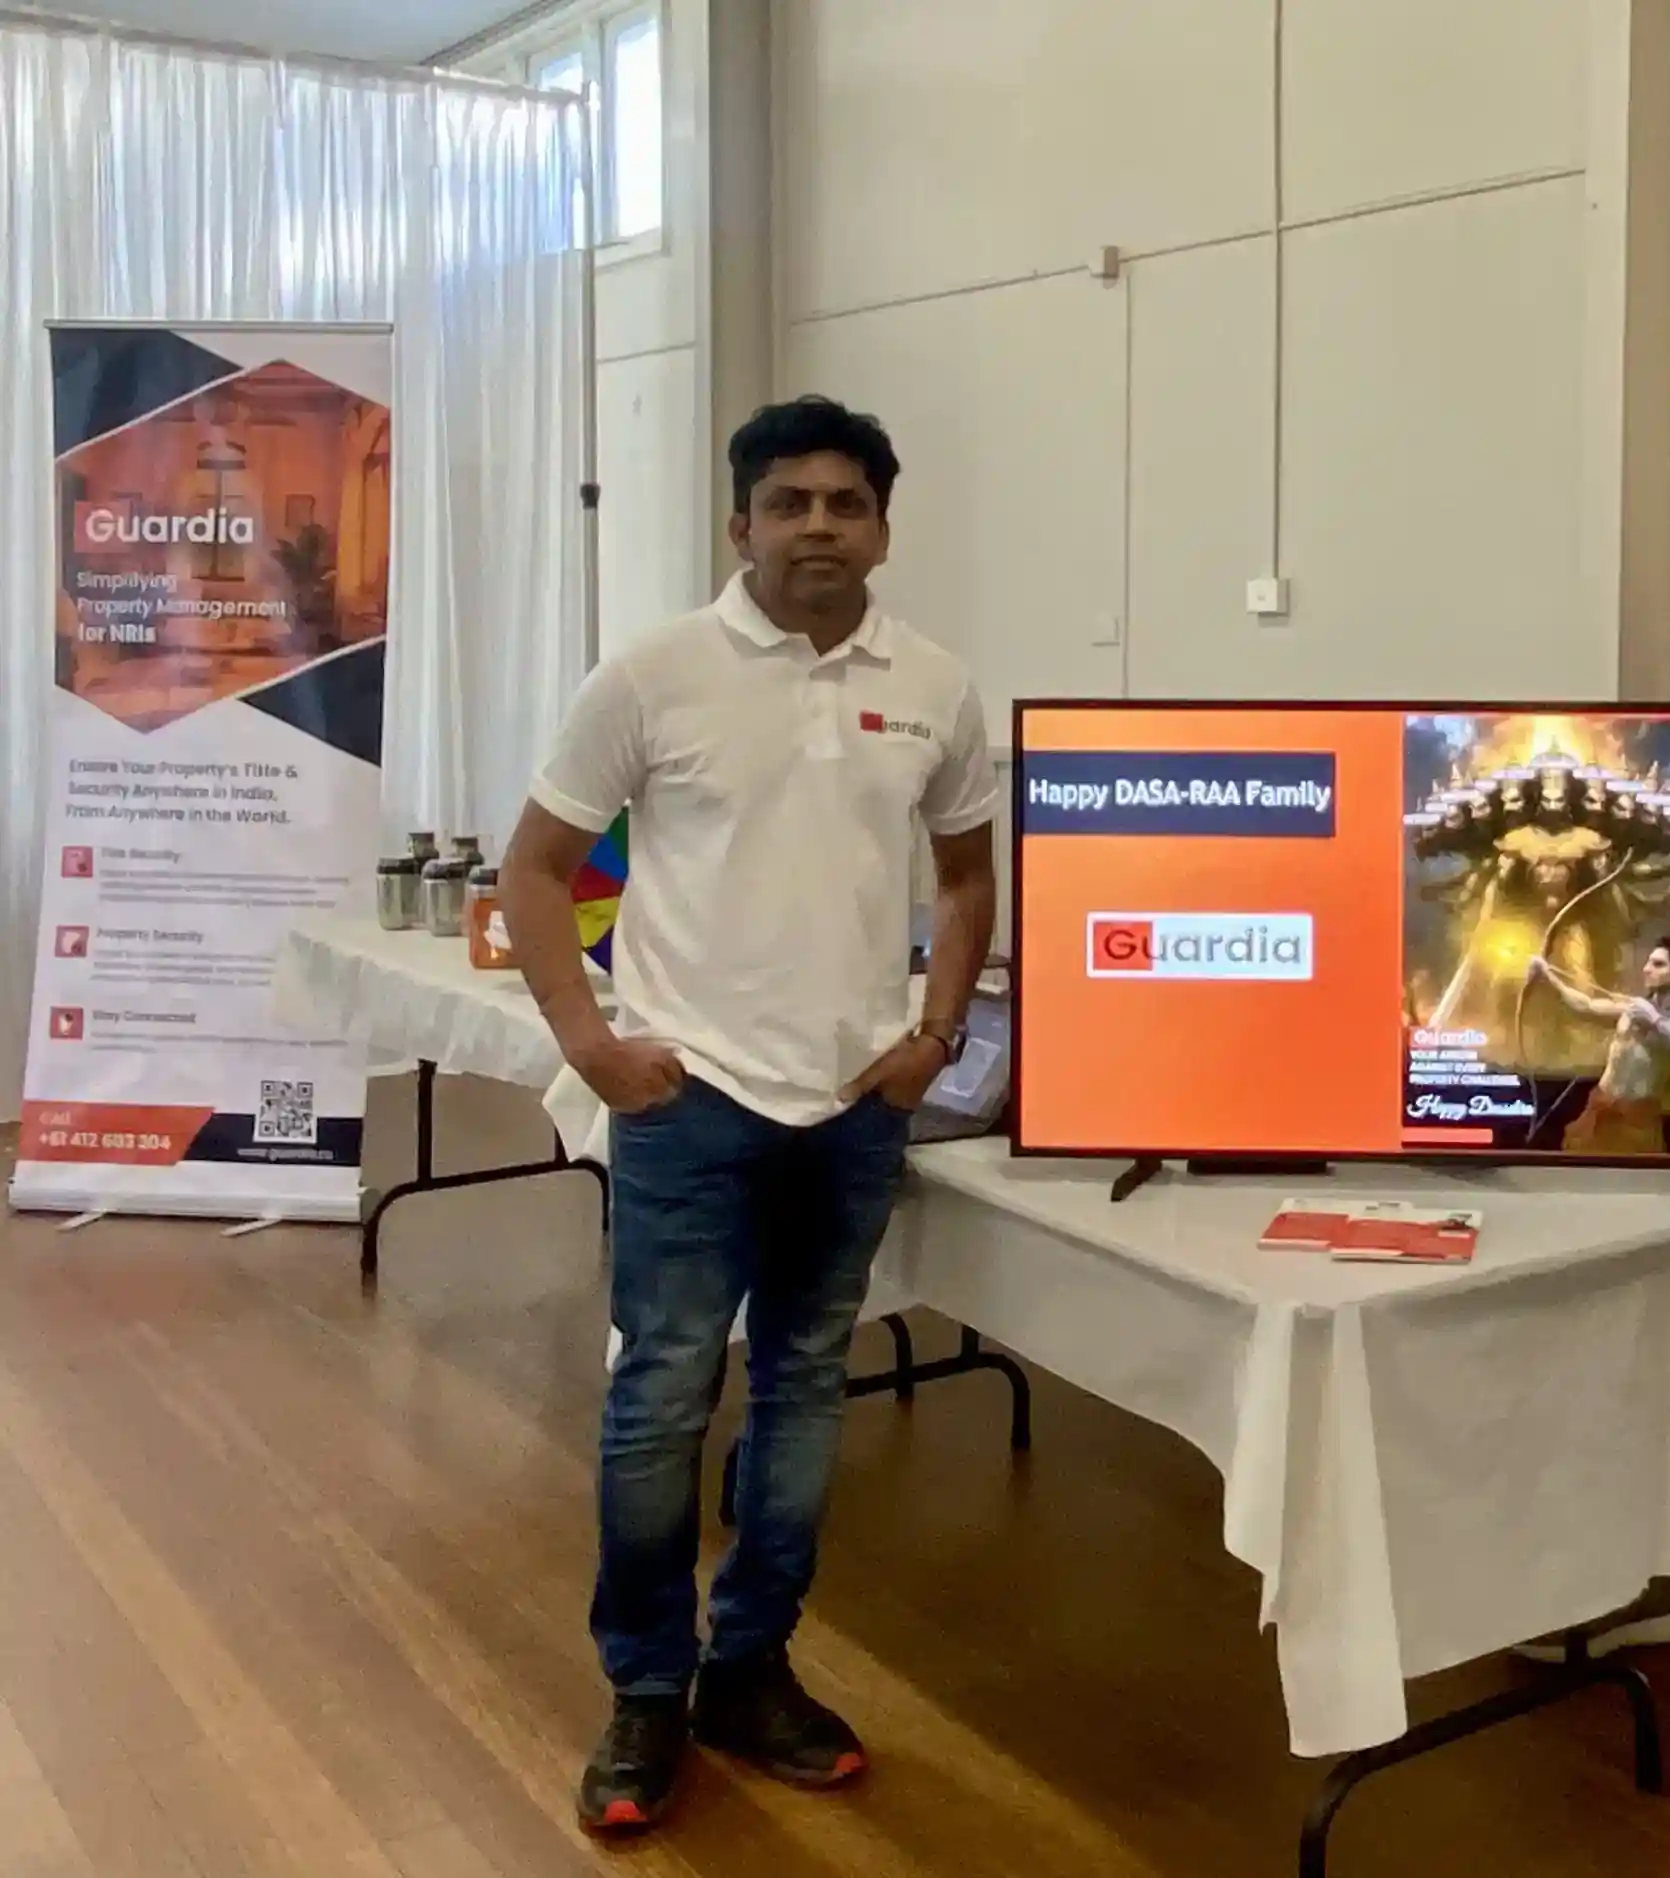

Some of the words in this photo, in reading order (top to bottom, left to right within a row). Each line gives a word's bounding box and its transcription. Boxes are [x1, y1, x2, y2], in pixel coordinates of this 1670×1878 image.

[85, 507, 254, 545] Guardia
[156, 600, 286, 621] Management
[243, 763, 280, 778] Title
[285, 764, 298, 779] &
[213, 785, 227, 799] in
[1029, 778, 1108, 811] Happy
[1115, 779, 1240, 806] DASA-RAA
[1246, 780, 1332, 813] Family
[108, 805, 184, 823] Anywhere
[189, 807, 202, 821] in
[205, 807, 231, 822] the
[1103, 926, 1301, 963] Guardia
[70, 1131, 98, 1148] 412
